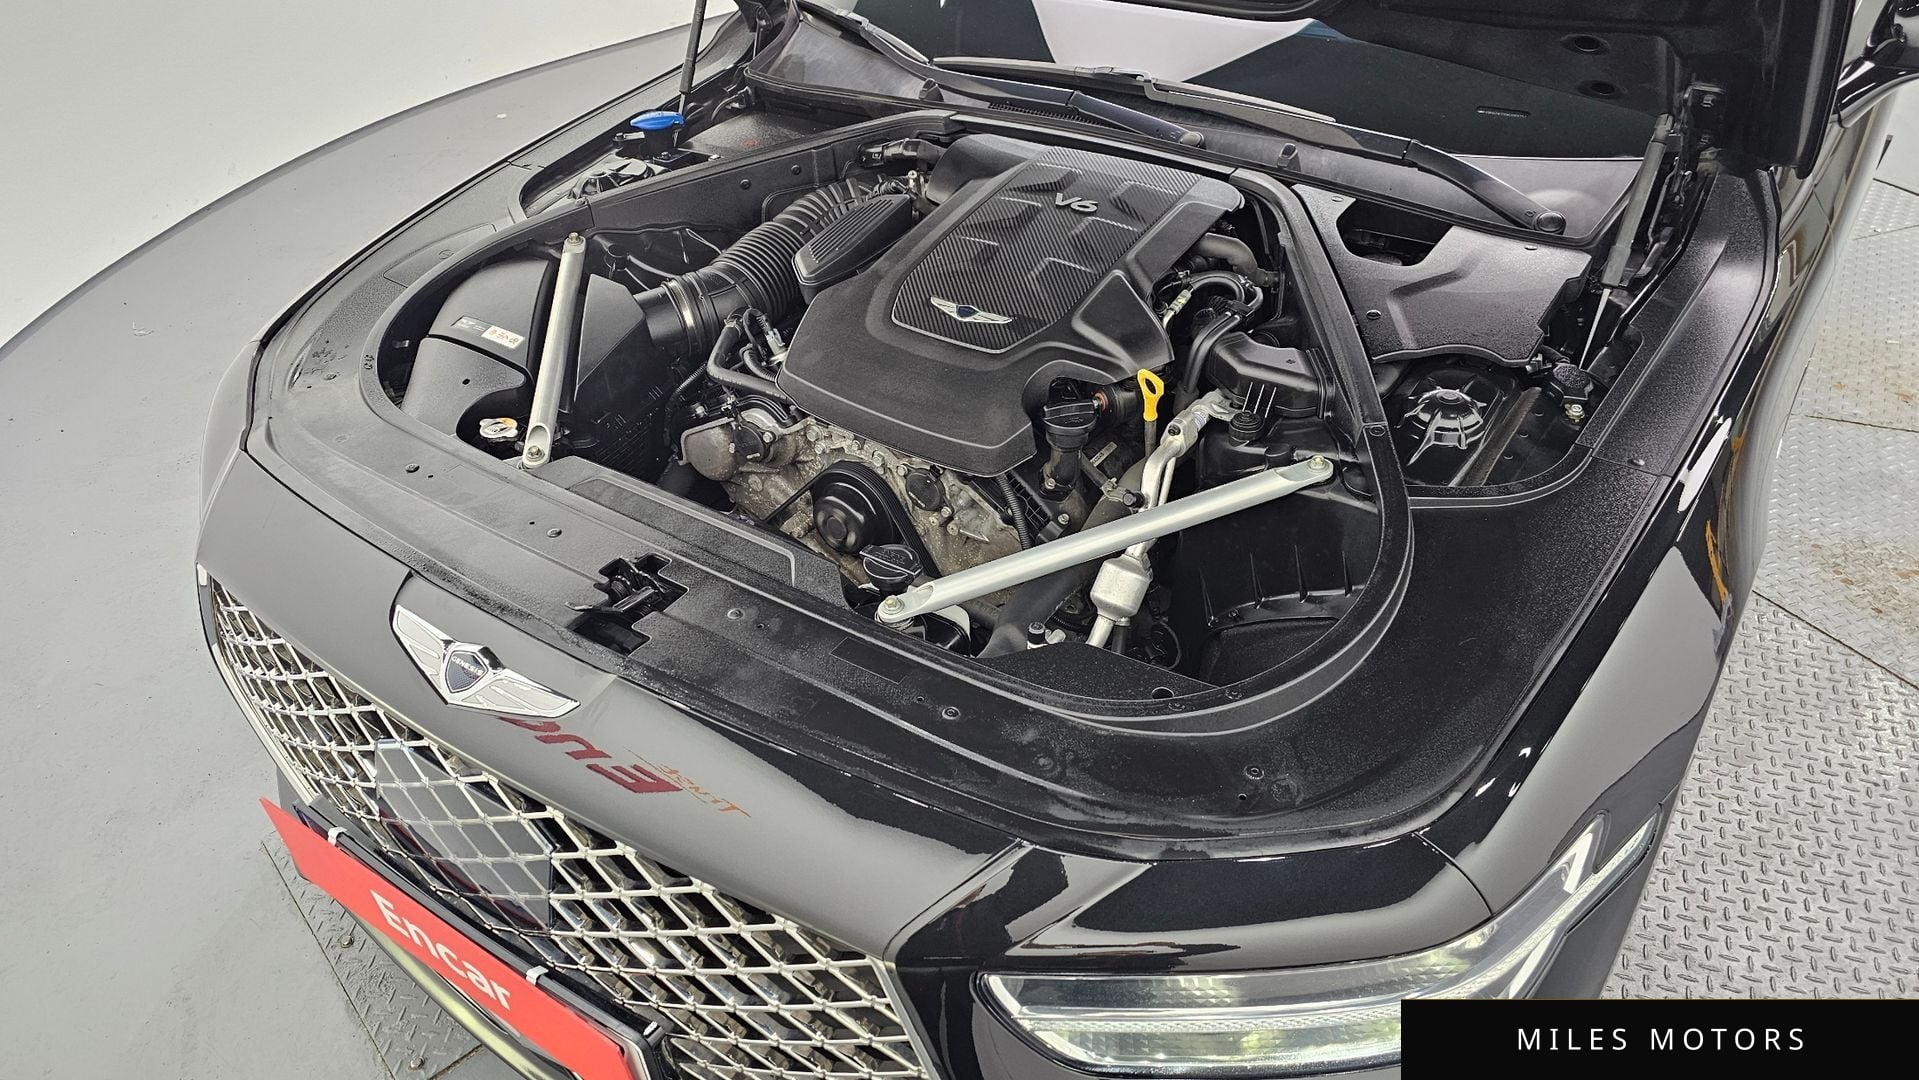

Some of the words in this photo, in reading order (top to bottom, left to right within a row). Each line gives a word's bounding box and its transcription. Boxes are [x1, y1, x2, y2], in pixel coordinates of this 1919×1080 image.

[1055, 192, 1098, 211] V6
[451, 655, 484, 676] GENESIS
[370, 889, 511, 1010] Encar
